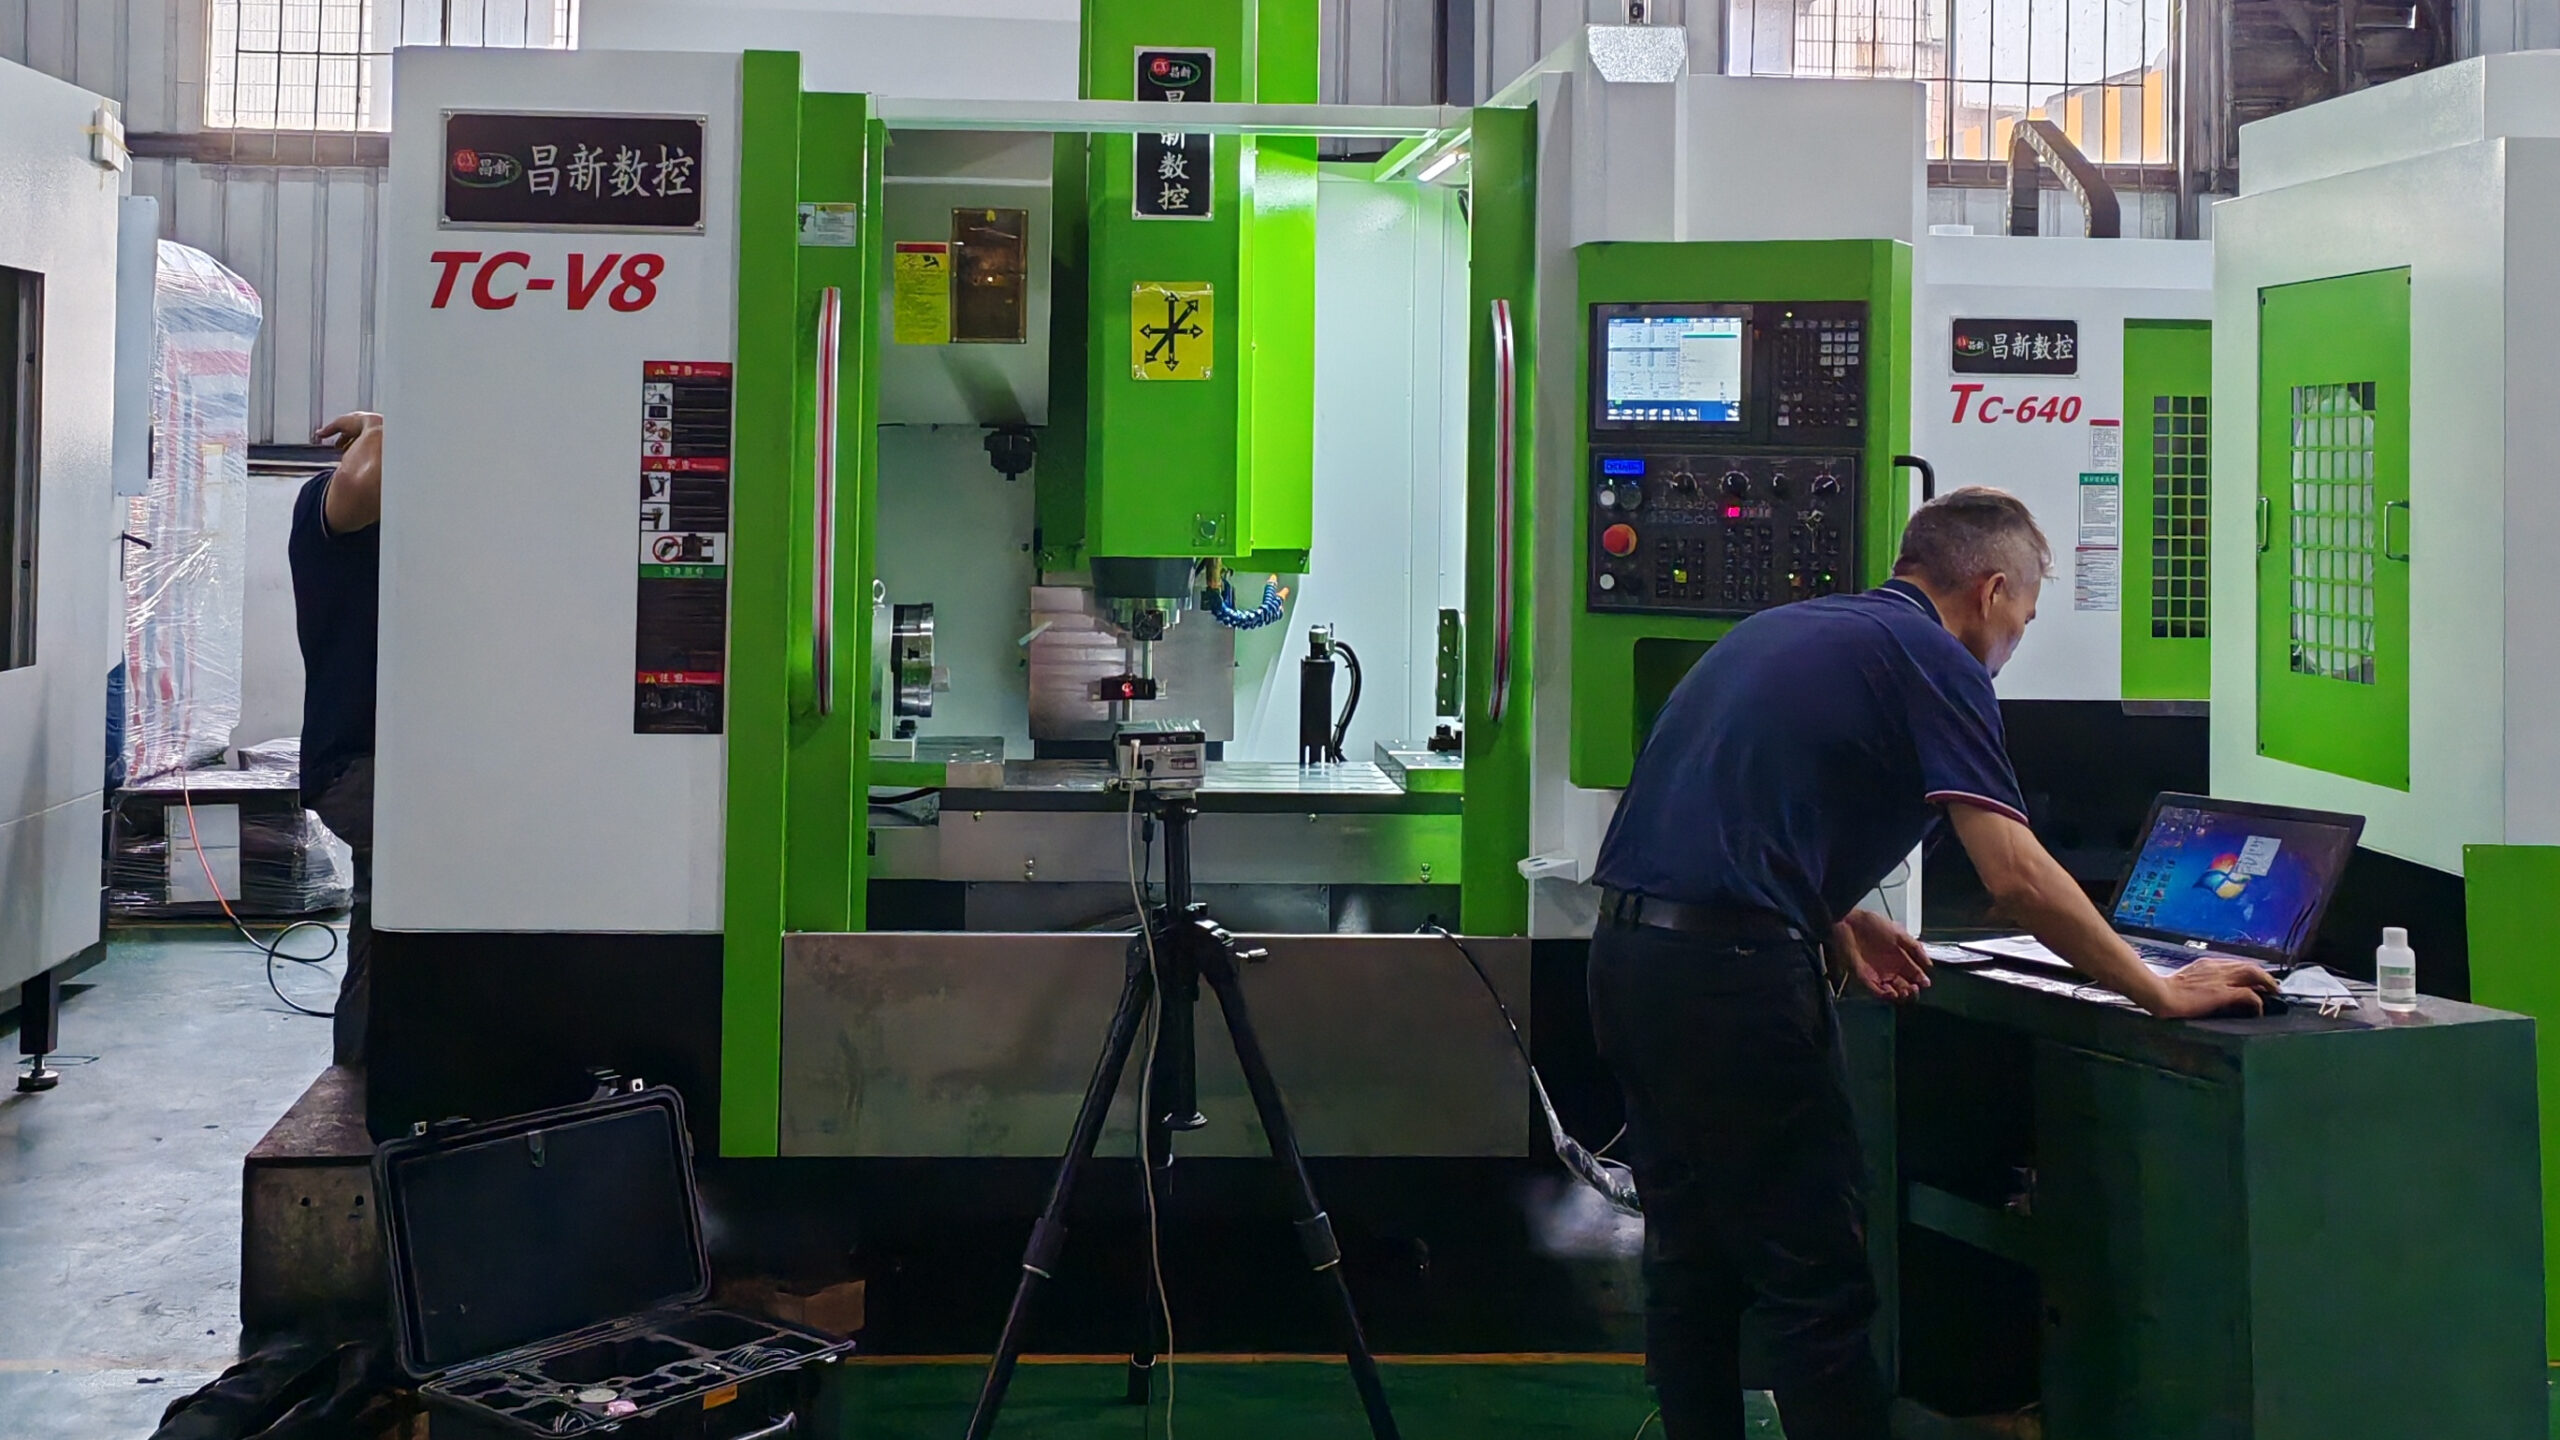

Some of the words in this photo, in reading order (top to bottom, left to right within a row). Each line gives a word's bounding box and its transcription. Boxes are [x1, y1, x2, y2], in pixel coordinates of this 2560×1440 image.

[478, 158, 513, 178] 昌新
[527, 143, 696, 199] 昌新数控
[430, 251, 665, 313] TC-V8
[1992, 332, 2075, 361] 昌新数控
